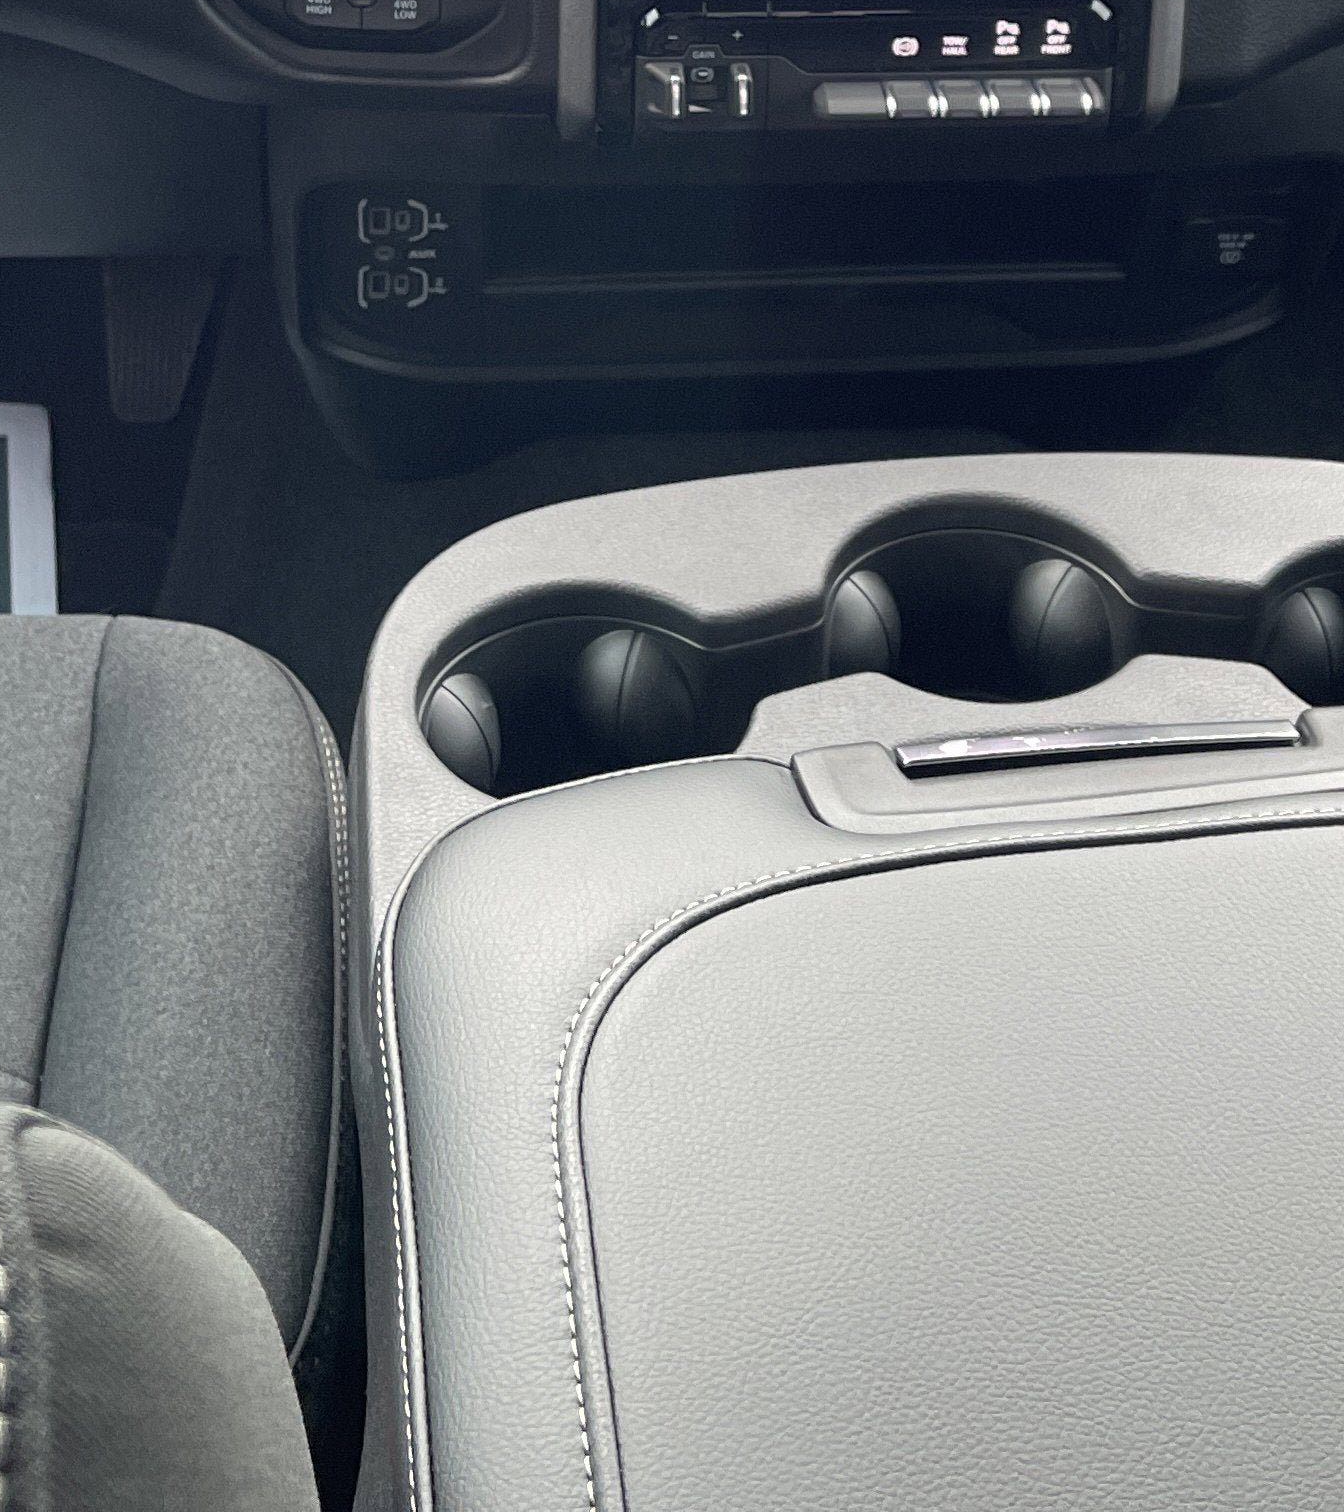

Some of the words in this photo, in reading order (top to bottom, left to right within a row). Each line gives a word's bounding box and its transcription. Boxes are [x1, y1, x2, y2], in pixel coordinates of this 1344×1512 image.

[394, 0, 417, 9] 4WD
[306, 5, 332, 15] HIGH
[394, 10, 417, 20] LOW
